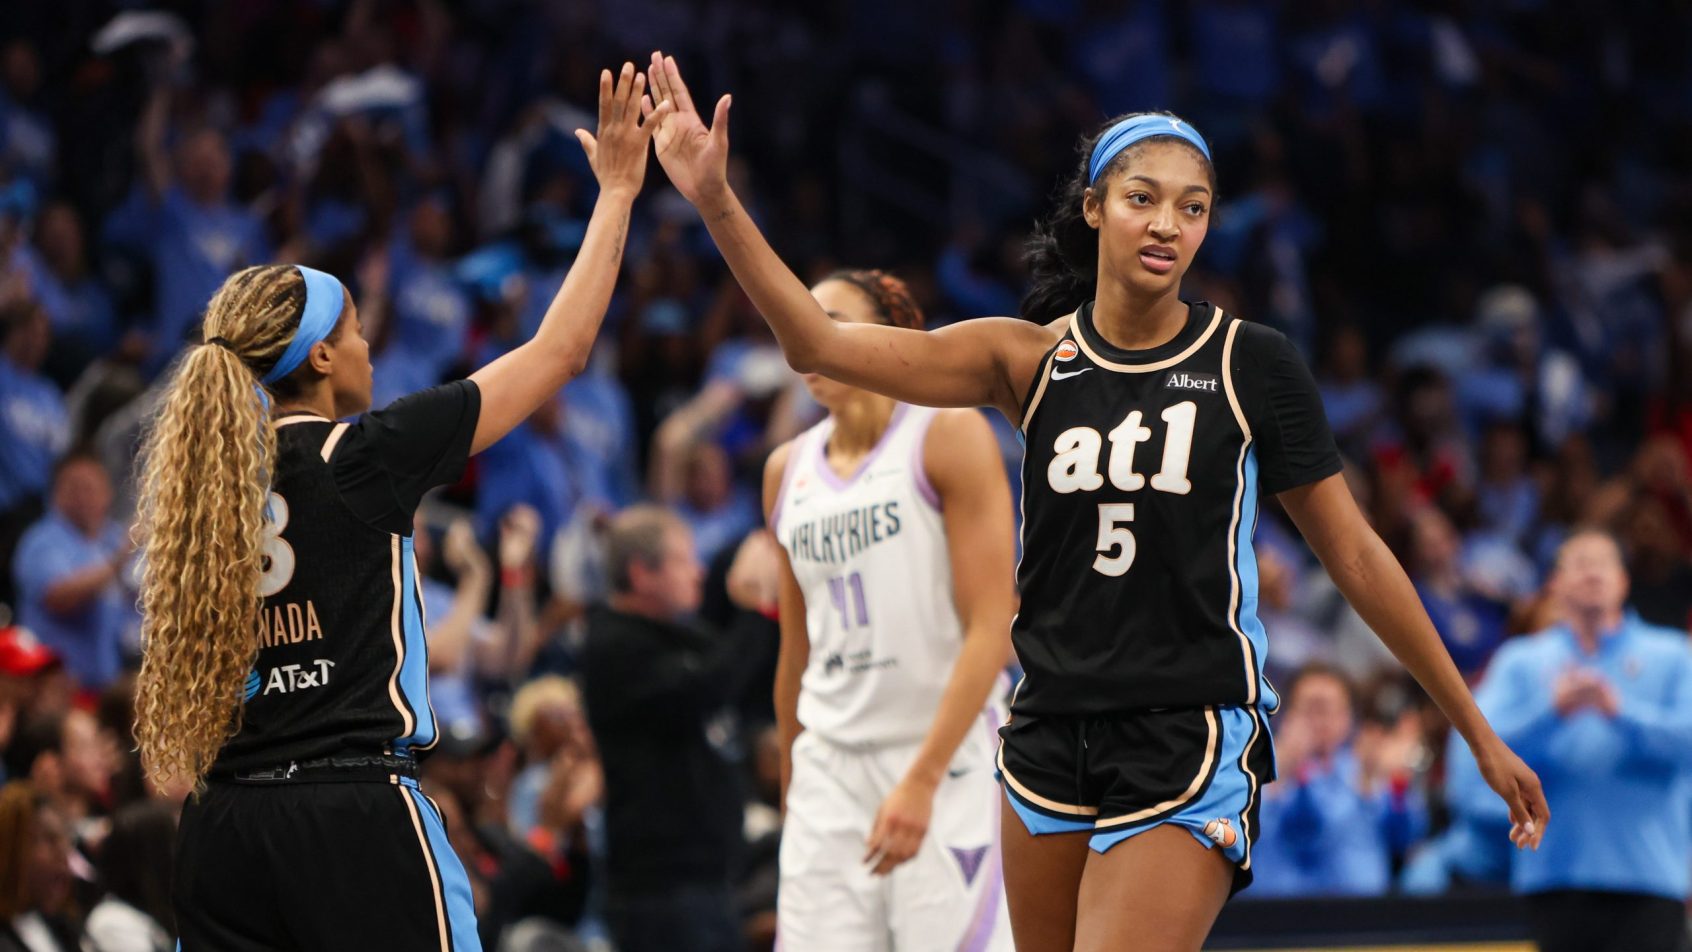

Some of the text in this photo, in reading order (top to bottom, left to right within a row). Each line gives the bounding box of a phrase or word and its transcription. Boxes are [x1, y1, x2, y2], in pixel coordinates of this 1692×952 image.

[1166, 373, 1218, 392] Albert
[790, 502, 901, 563] VALKYRIES
[1092, 502, 1136, 577] 5
[258, 600, 323, 649] NADA
[827, 572, 868, 630] 41
[262, 658, 336, 696] AT&T
